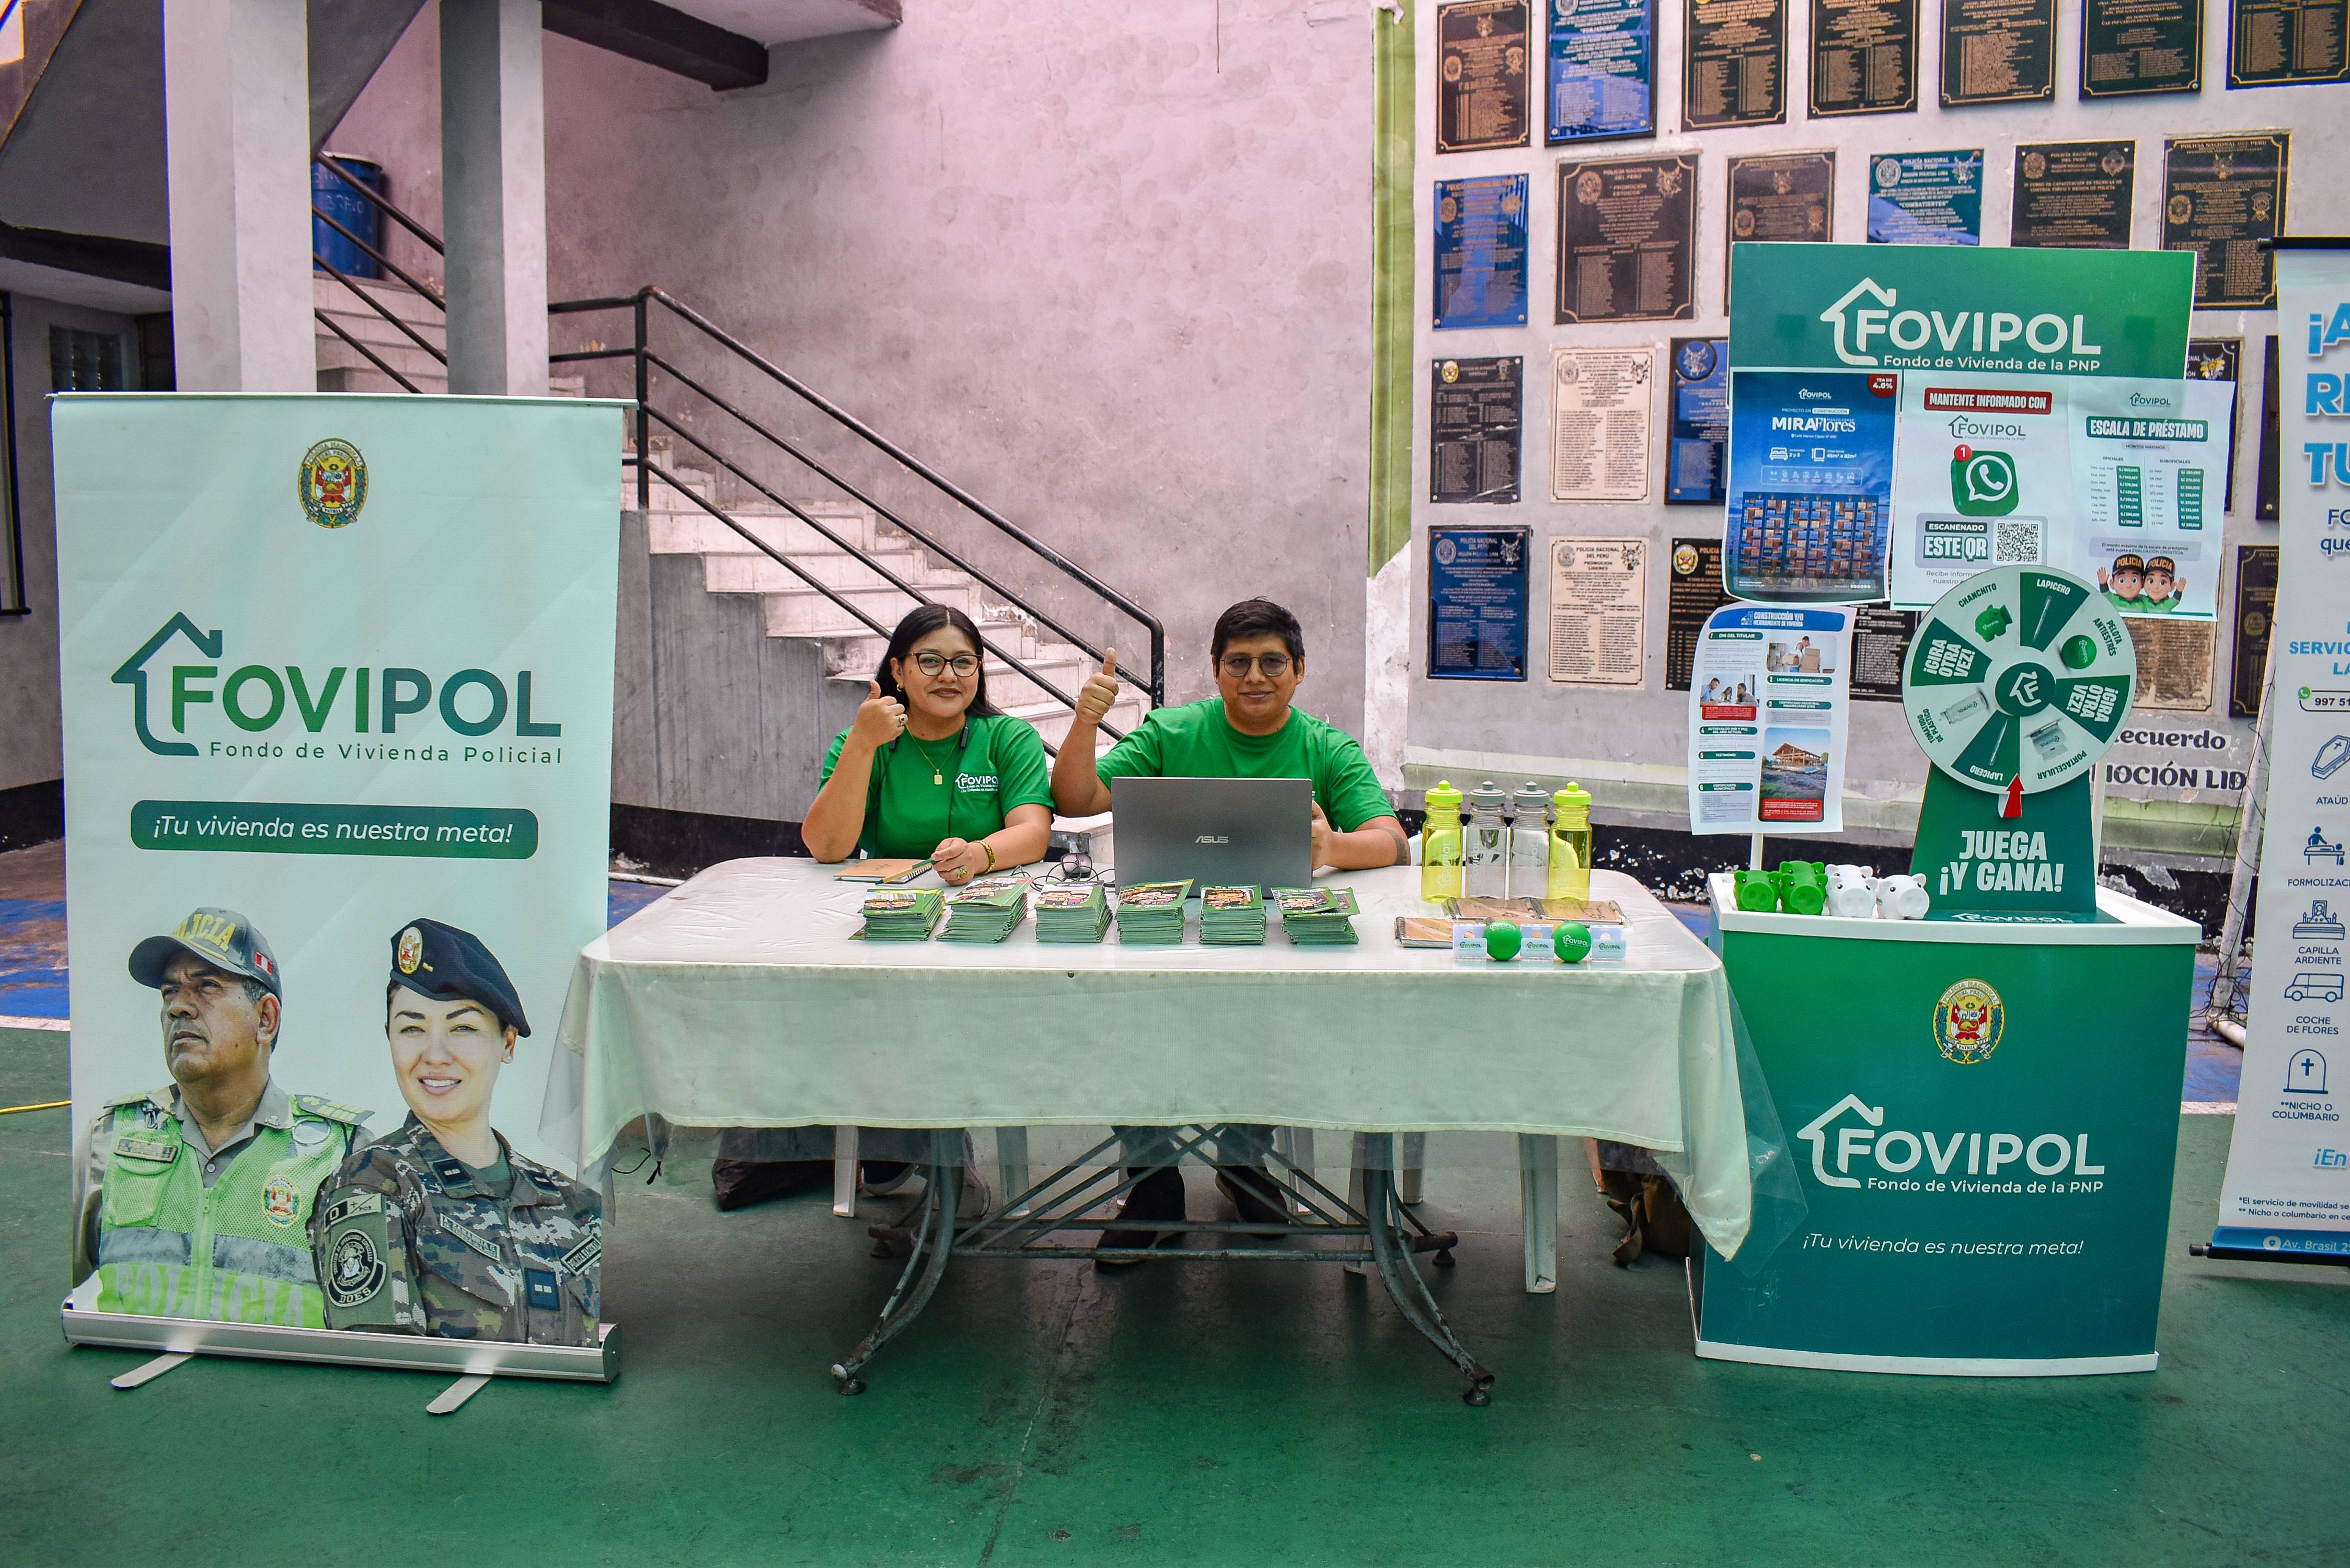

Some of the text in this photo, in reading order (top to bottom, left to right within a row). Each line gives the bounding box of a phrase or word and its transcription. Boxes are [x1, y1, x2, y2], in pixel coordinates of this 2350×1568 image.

[1857, 309, 2101, 355] FOVIPOL
[1884, 355, 2100, 372] Fondo de Vivienda de la PNP
[1929, 393, 2046, 409] MANTENTE INFORMADO CON
[2135, 397, 2171, 405] FOVIPOL
[2306, 373, 2350, 414] R
[1959, 423, 2026, 436] FOVIPOL
[2090, 420, 2203, 439] ESCALA DE PRÉSTAMO
[1961, 447, 1965, 457] 1
[1929, 523, 1985, 532] ESCANENADO
[1924, 536, 1988, 561] ESTE QR
[2117, 557, 2141, 567] POLICIA
[2148, 559, 2172, 570] POLICIA
[1958, 583, 1997, 608] CHANCHITO
[2036, 578, 2070, 596] LAPICERO
[1754, 611, 1793, 620] CONSTRUCCIÓN
[2093, 618, 2116, 657] ANTIESTRÉS
[2106, 619, 2123, 644] PELOTA
[1923, 639, 1947, 675] ¡GIRA
[1938, 643, 1961, 677] OTRA
[1954, 649, 1975, 677] VEZ!
[171, 664, 561, 737] FOVIPOL
[2066, 684, 2088, 713] VEZ!
[2080, 684, 2105, 718] OTRA
[2094, 687, 2118, 723] ¡GIRA
[1917, 714, 1934, 744] TOMATODO
[2115, 730, 2226, 750] ecuerdo
[210, 741, 561, 764] Fondo de Vivienda Policial
[1969, 765, 2003, 781] LAPICERO
[2037, 750, 2087, 780] PORTACELULAR
[2316, 796, 2348, 805] ATAÚD
[154, 815, 513, 845] ¡Tu vivienda es nuestra meta!
[1195, 835, 1229, 844] ASUS
[1959, 831, 2047, 861] JUEGA
[1939, 861, 2063, 895] ¡Y GANA!
[1565, 937, 1588, 946] FOVIPOL
[2298, 947, 2339, 955] CAPILLA
[2296, 1016, 2331, 1024] COCHE
[2287, 1025, 2339, 1035] DE FLORES
[2272, 1111, 2340, 1121] COLUMBARIO
[2324, 1103, 2332, 1111] O
[1837, 1128, 2105, 1175] FOVIPOL
[2314, 1148, 2347, 1167] ¡En
[1868, 1177, 2103, 1194] Fondo de Vivienda de la PNP
[2252, 1197, 2284, 1207] servicio
[2299, 1200, 2338, 1209] movilidad
[2249, 1208, 2272, 1217] Nicho
[2282, 1210, 2326, 1219] columbario
[1803, 1233, 2083, 1255] ¡Tu vivienda es nuestra meta!
[2282, 1239, 2336, 1251] Av. Brasil
[339, 1287, 372, 1303] DOES
